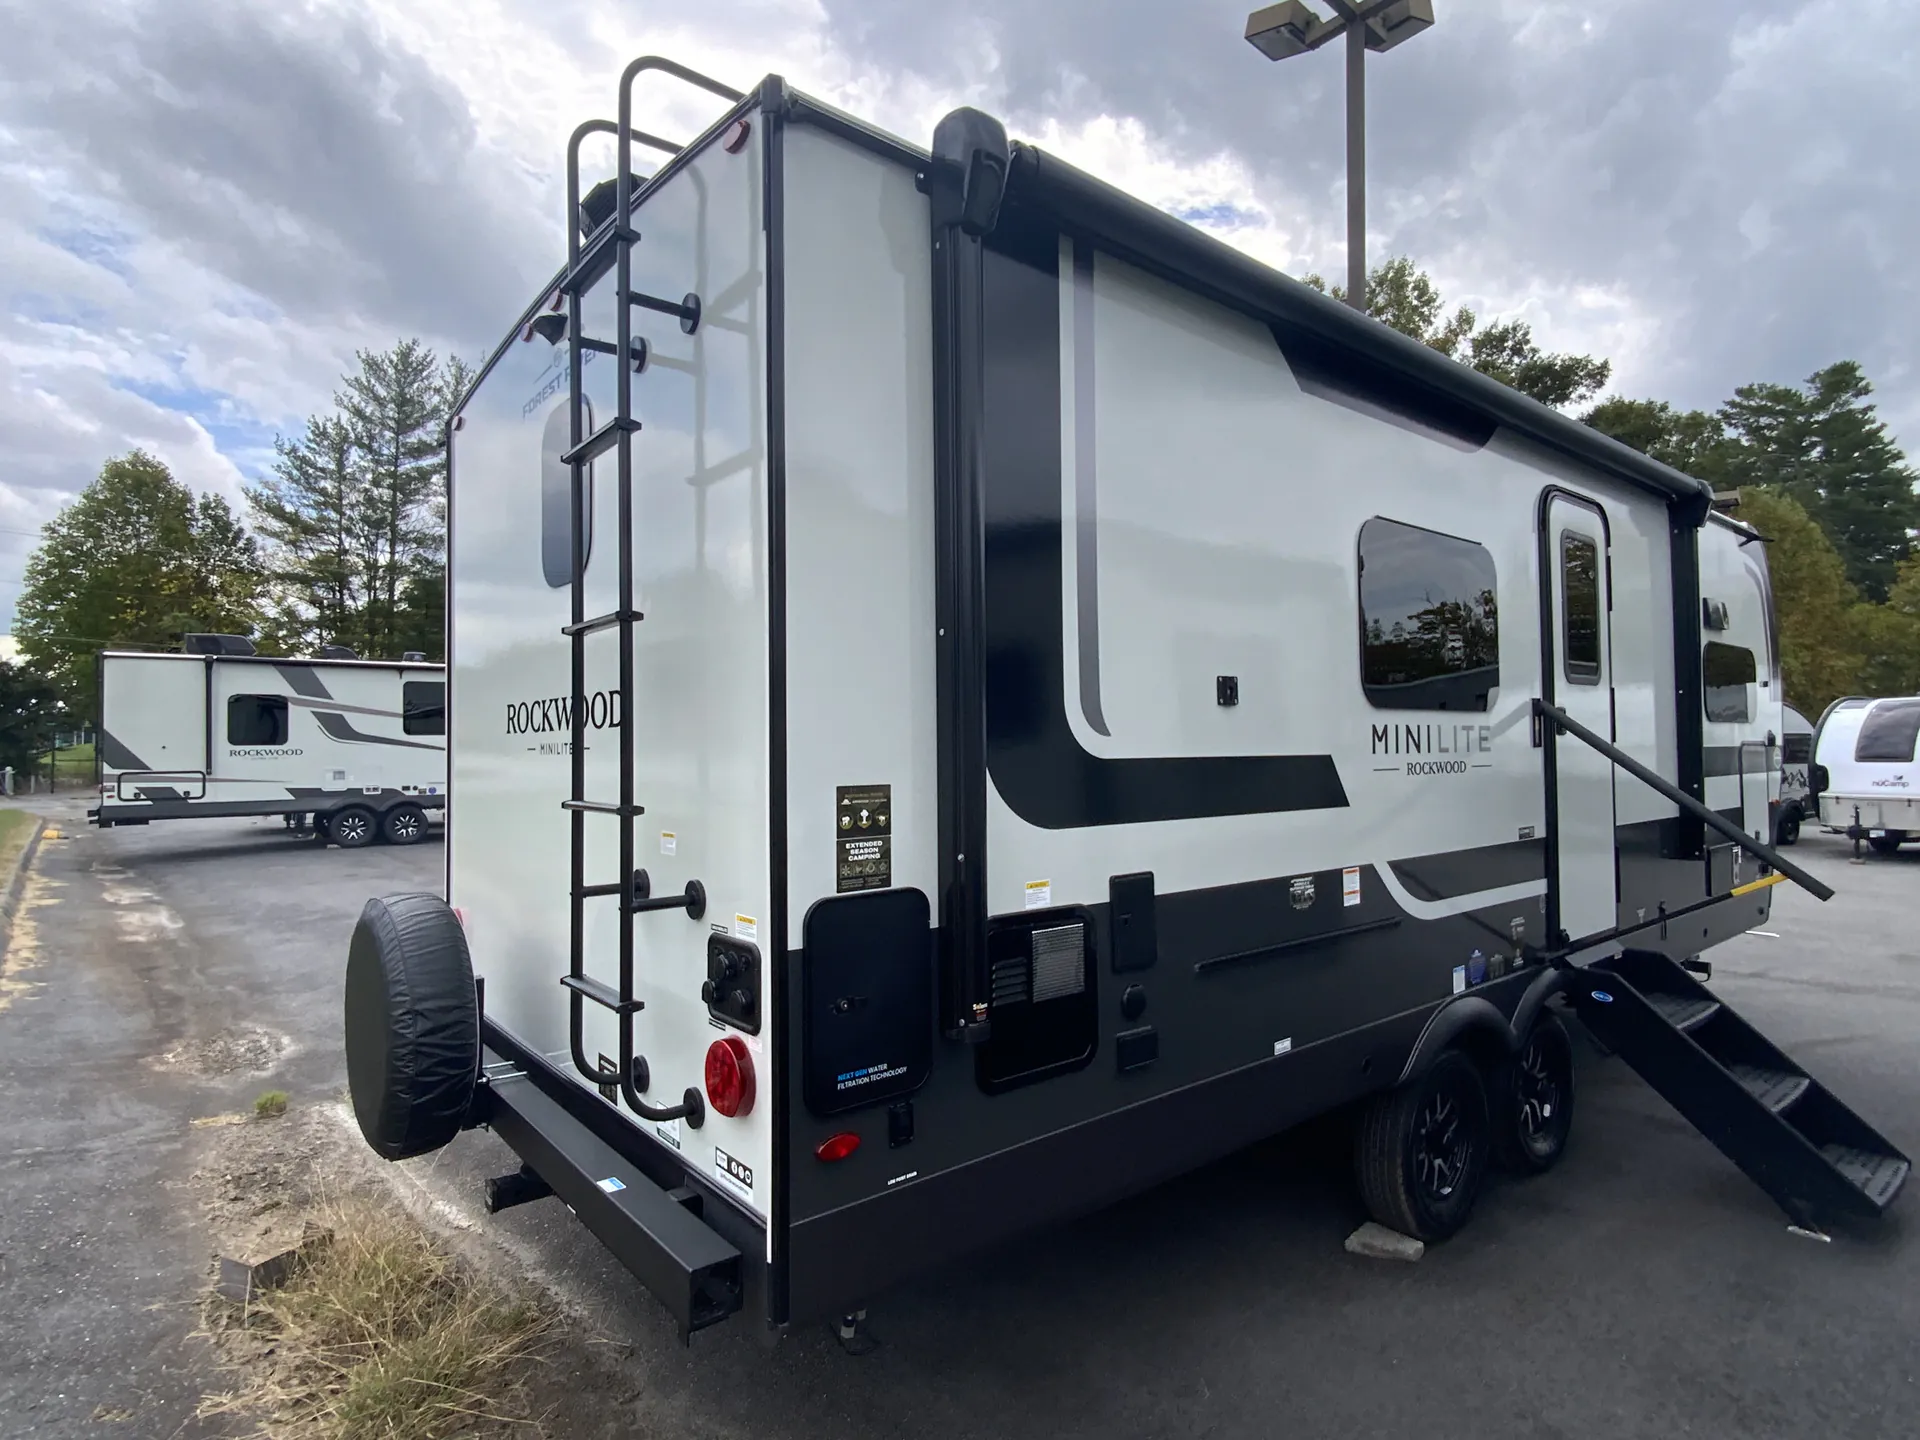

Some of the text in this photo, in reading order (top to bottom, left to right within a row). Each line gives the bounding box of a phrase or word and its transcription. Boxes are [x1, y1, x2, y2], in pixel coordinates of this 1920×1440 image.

[506, 690, 621, 734] ROCKWOD
[1372, 724, 1492, 754] MINILITE
[229, 748, 304, 757] ROCKWOOD
[1406, 760, 1467, 775] ROCKWOOD
[846, 840, 883, 849] EXTENDED
[850, 847, 879, 855] SEASON
[848, 852, 881, 861] CAMPING
[837, 1063, 888, 1081] NEXT GEN WATER
[837, 1066, 908, 1090] FILTRATION TECHNOLOGY
